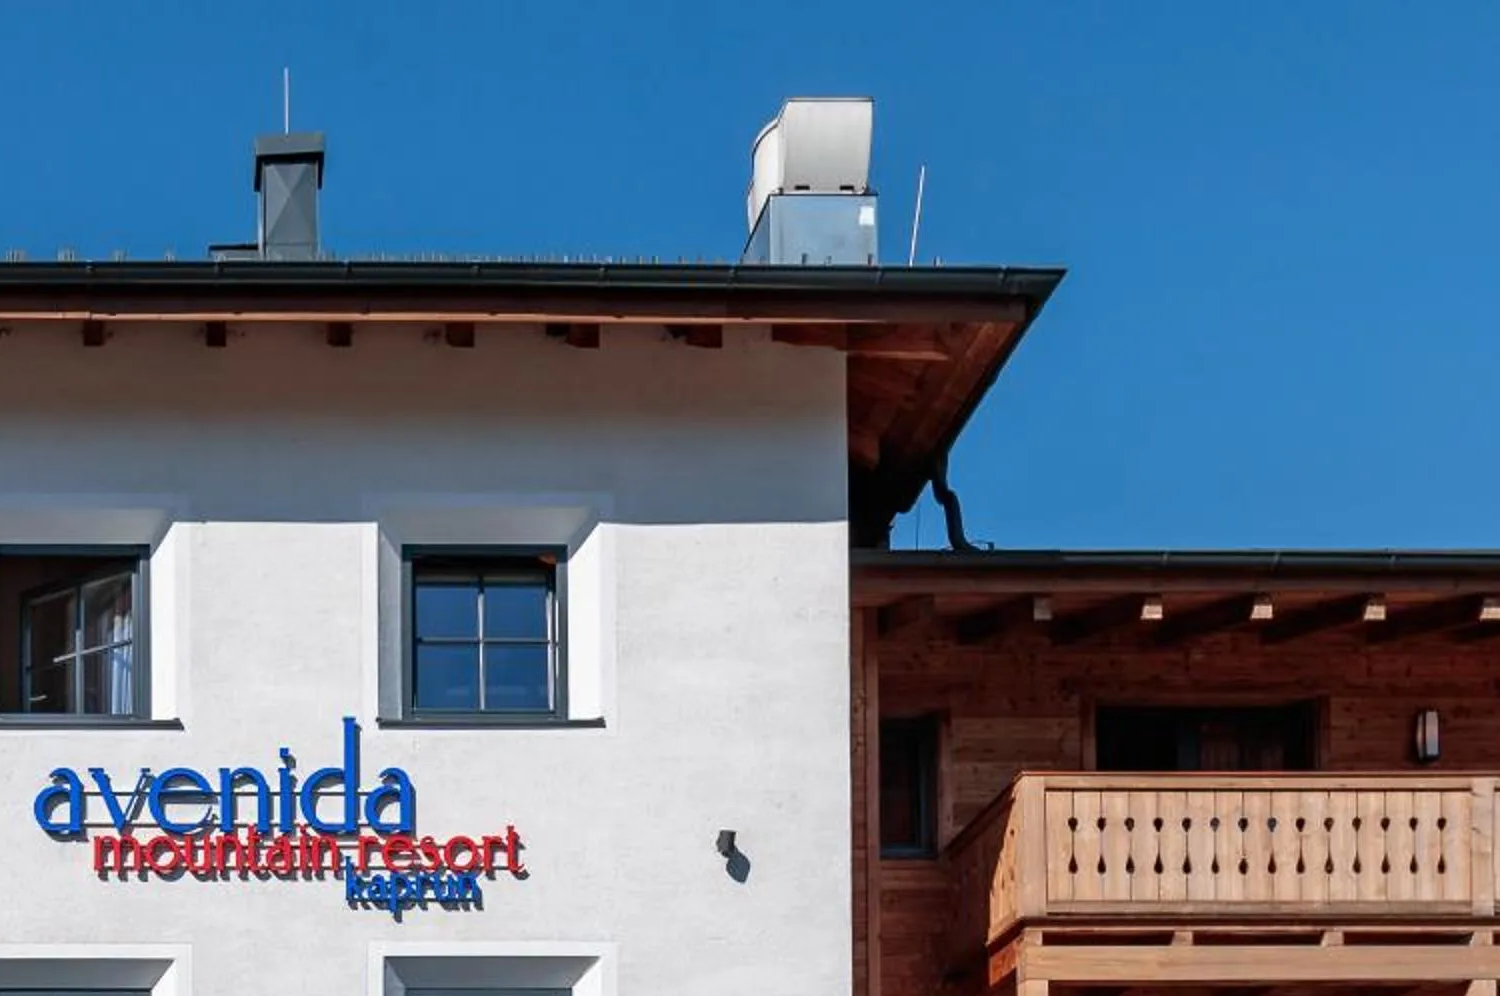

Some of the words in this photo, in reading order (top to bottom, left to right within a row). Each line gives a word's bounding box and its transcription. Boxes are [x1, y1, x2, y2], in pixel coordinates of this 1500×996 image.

[33, 716, 417, 835] avenida
[93, 825, 339, 873] mountain
[357, 825, 524, 873] resort
[345, 857, 481, 913] kaprun
